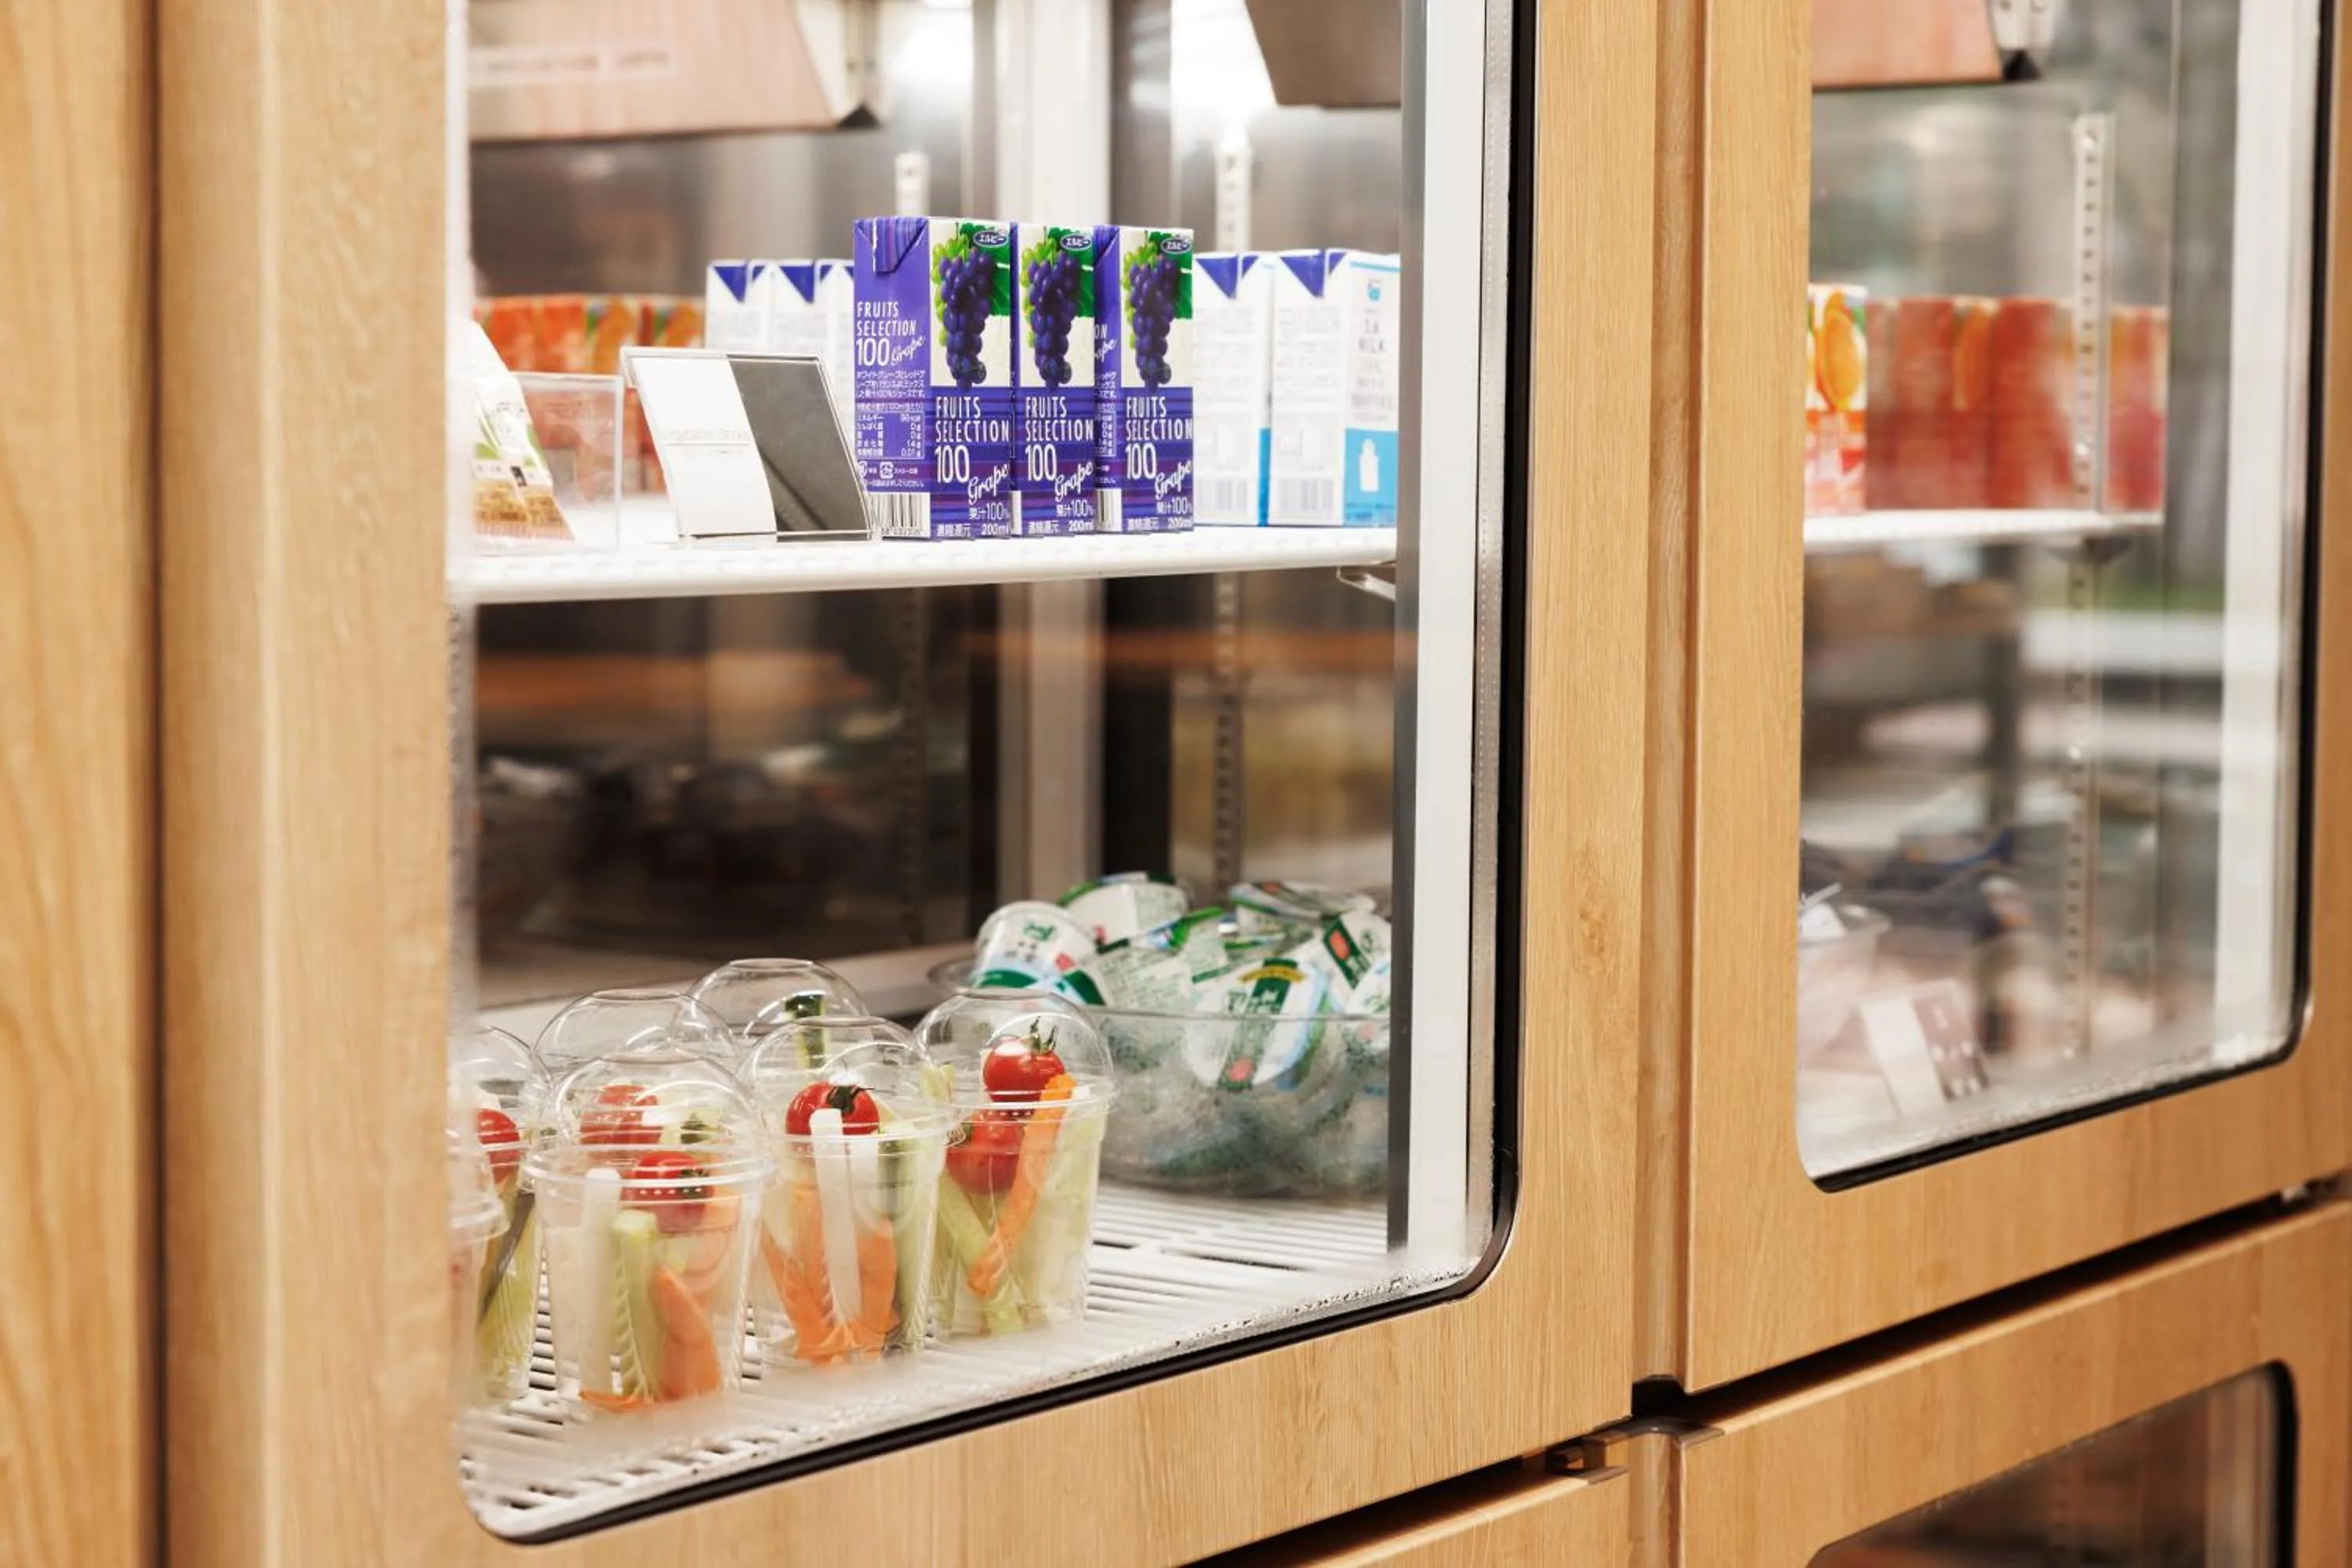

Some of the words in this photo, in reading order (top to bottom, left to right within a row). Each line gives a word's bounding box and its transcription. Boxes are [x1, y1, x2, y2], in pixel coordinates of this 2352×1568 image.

[857, 301, 899, 318] FRUITS
[857, 320, 916, 336] SELECTION
[856, 337, 890, 366] 100
[891, 335, 926, 366] Grape
[936, 396, 981, 419] FRUITS
[1025, 396, 1067, 418] FRUITS
[1127, 396, 1167, 418] FRUITS
[935, 420, 1010, 442] SELECTION
[1025, 419, 1094, 441] SELECTION
[1126, 418, 1192, 441] SELECTION
[935, 445, 970, 483] 100
[1025, 444, 1057, 481] 100
[1125, 442, 1156, 480] 100
[967, 463, 1010, 505] Grape
[1055, 460, 1094, 502] Grape
[1155, 459, 1192, 500] Grape
